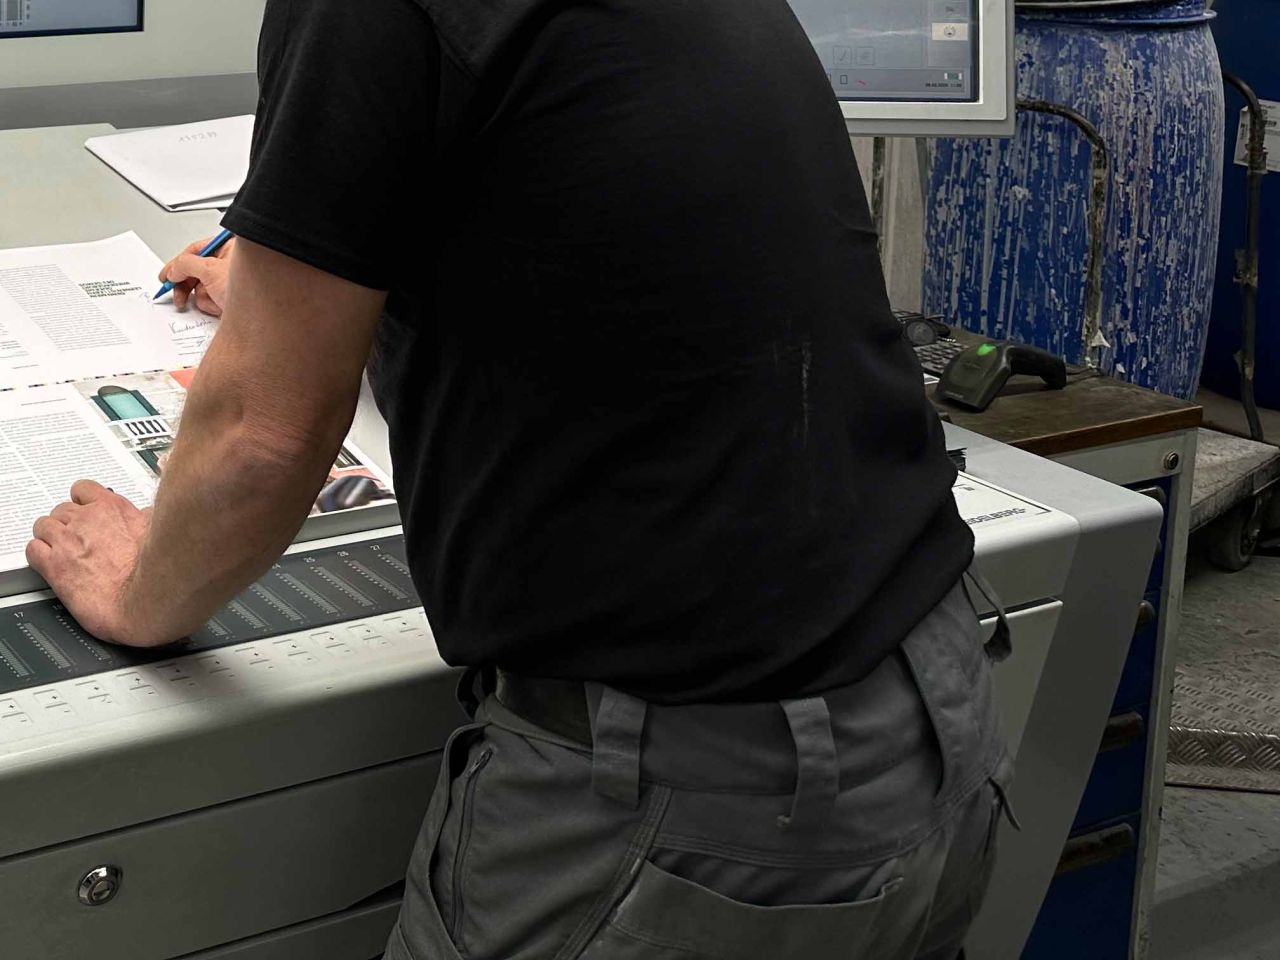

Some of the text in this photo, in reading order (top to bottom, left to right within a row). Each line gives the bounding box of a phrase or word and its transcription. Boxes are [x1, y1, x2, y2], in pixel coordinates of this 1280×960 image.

[966, 508, 1026, 525] EIDELBERG
[13, 611, 25, 619] 17
[370, 544, 381, 552] 27
